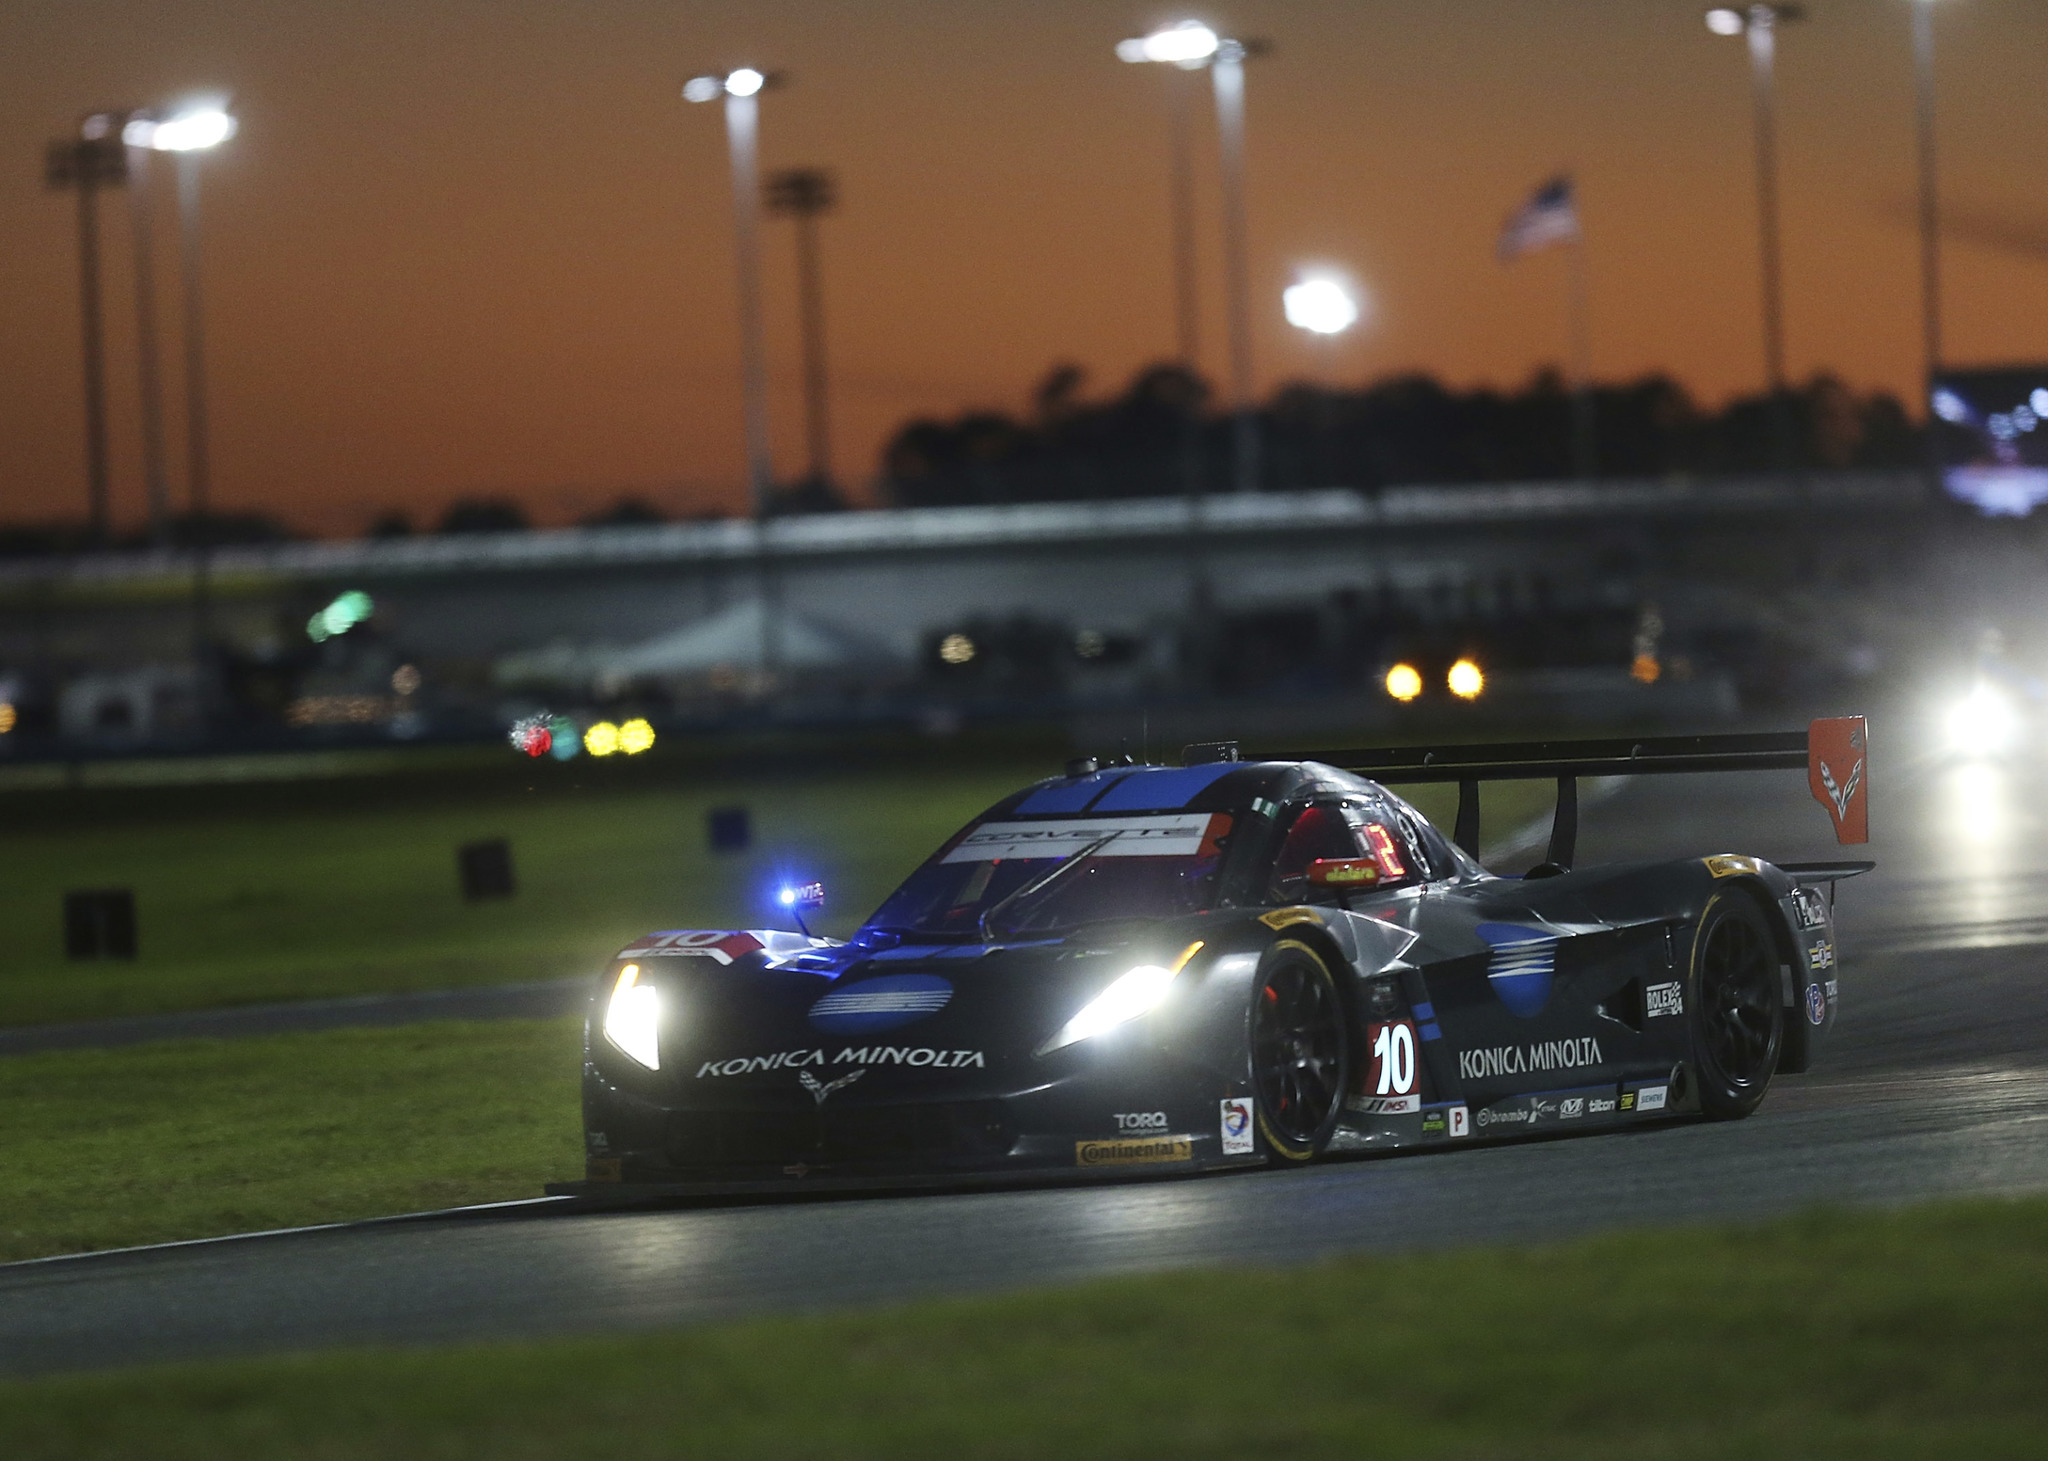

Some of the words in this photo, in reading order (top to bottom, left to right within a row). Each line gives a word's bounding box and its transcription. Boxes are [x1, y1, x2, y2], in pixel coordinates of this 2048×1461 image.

[655, 932, 730, 948] 10
[697, 1049, 824, 1077] KONICA
[833, 1046, 985, 1068] MINOLTA
[1374, 1023, 1415, 1095] 10
[1459, 1046, 1526, 1079] KONICA
[1529, 1036, 1602, 1073] MINOLTA
[1113, 1111, 1168, 1128] TORQ
[1081, 1141, 1175, 1163] Continental
